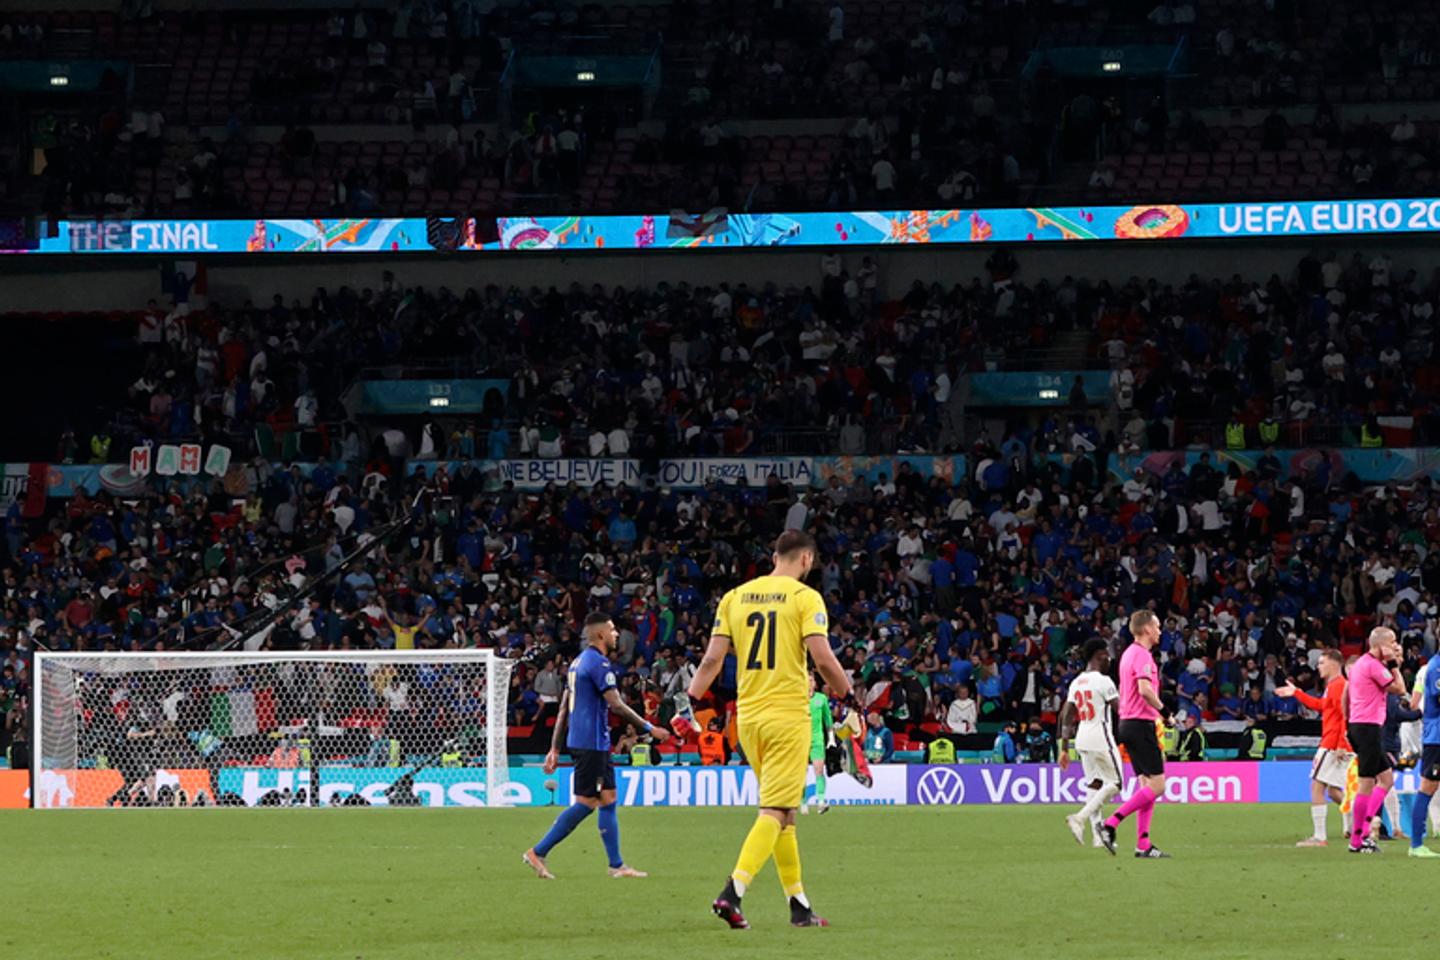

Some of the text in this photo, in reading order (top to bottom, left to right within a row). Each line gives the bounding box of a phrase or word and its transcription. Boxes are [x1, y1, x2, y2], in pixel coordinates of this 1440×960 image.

[1219, 204, 1306, 233] UEFA
[1311, 201, 1402, 230] EURO
[68, 222, 219, 251] THE FINAL
[501, 461, 524, 480] WE
[528, 460, 615, 482] BELIEVE
[660, 461, 705, 484] OU!
[754, 460, 810, 480] ITALIA
[746, 611, 777, 672] 21
[1074, 690, 1096, 721] 25
